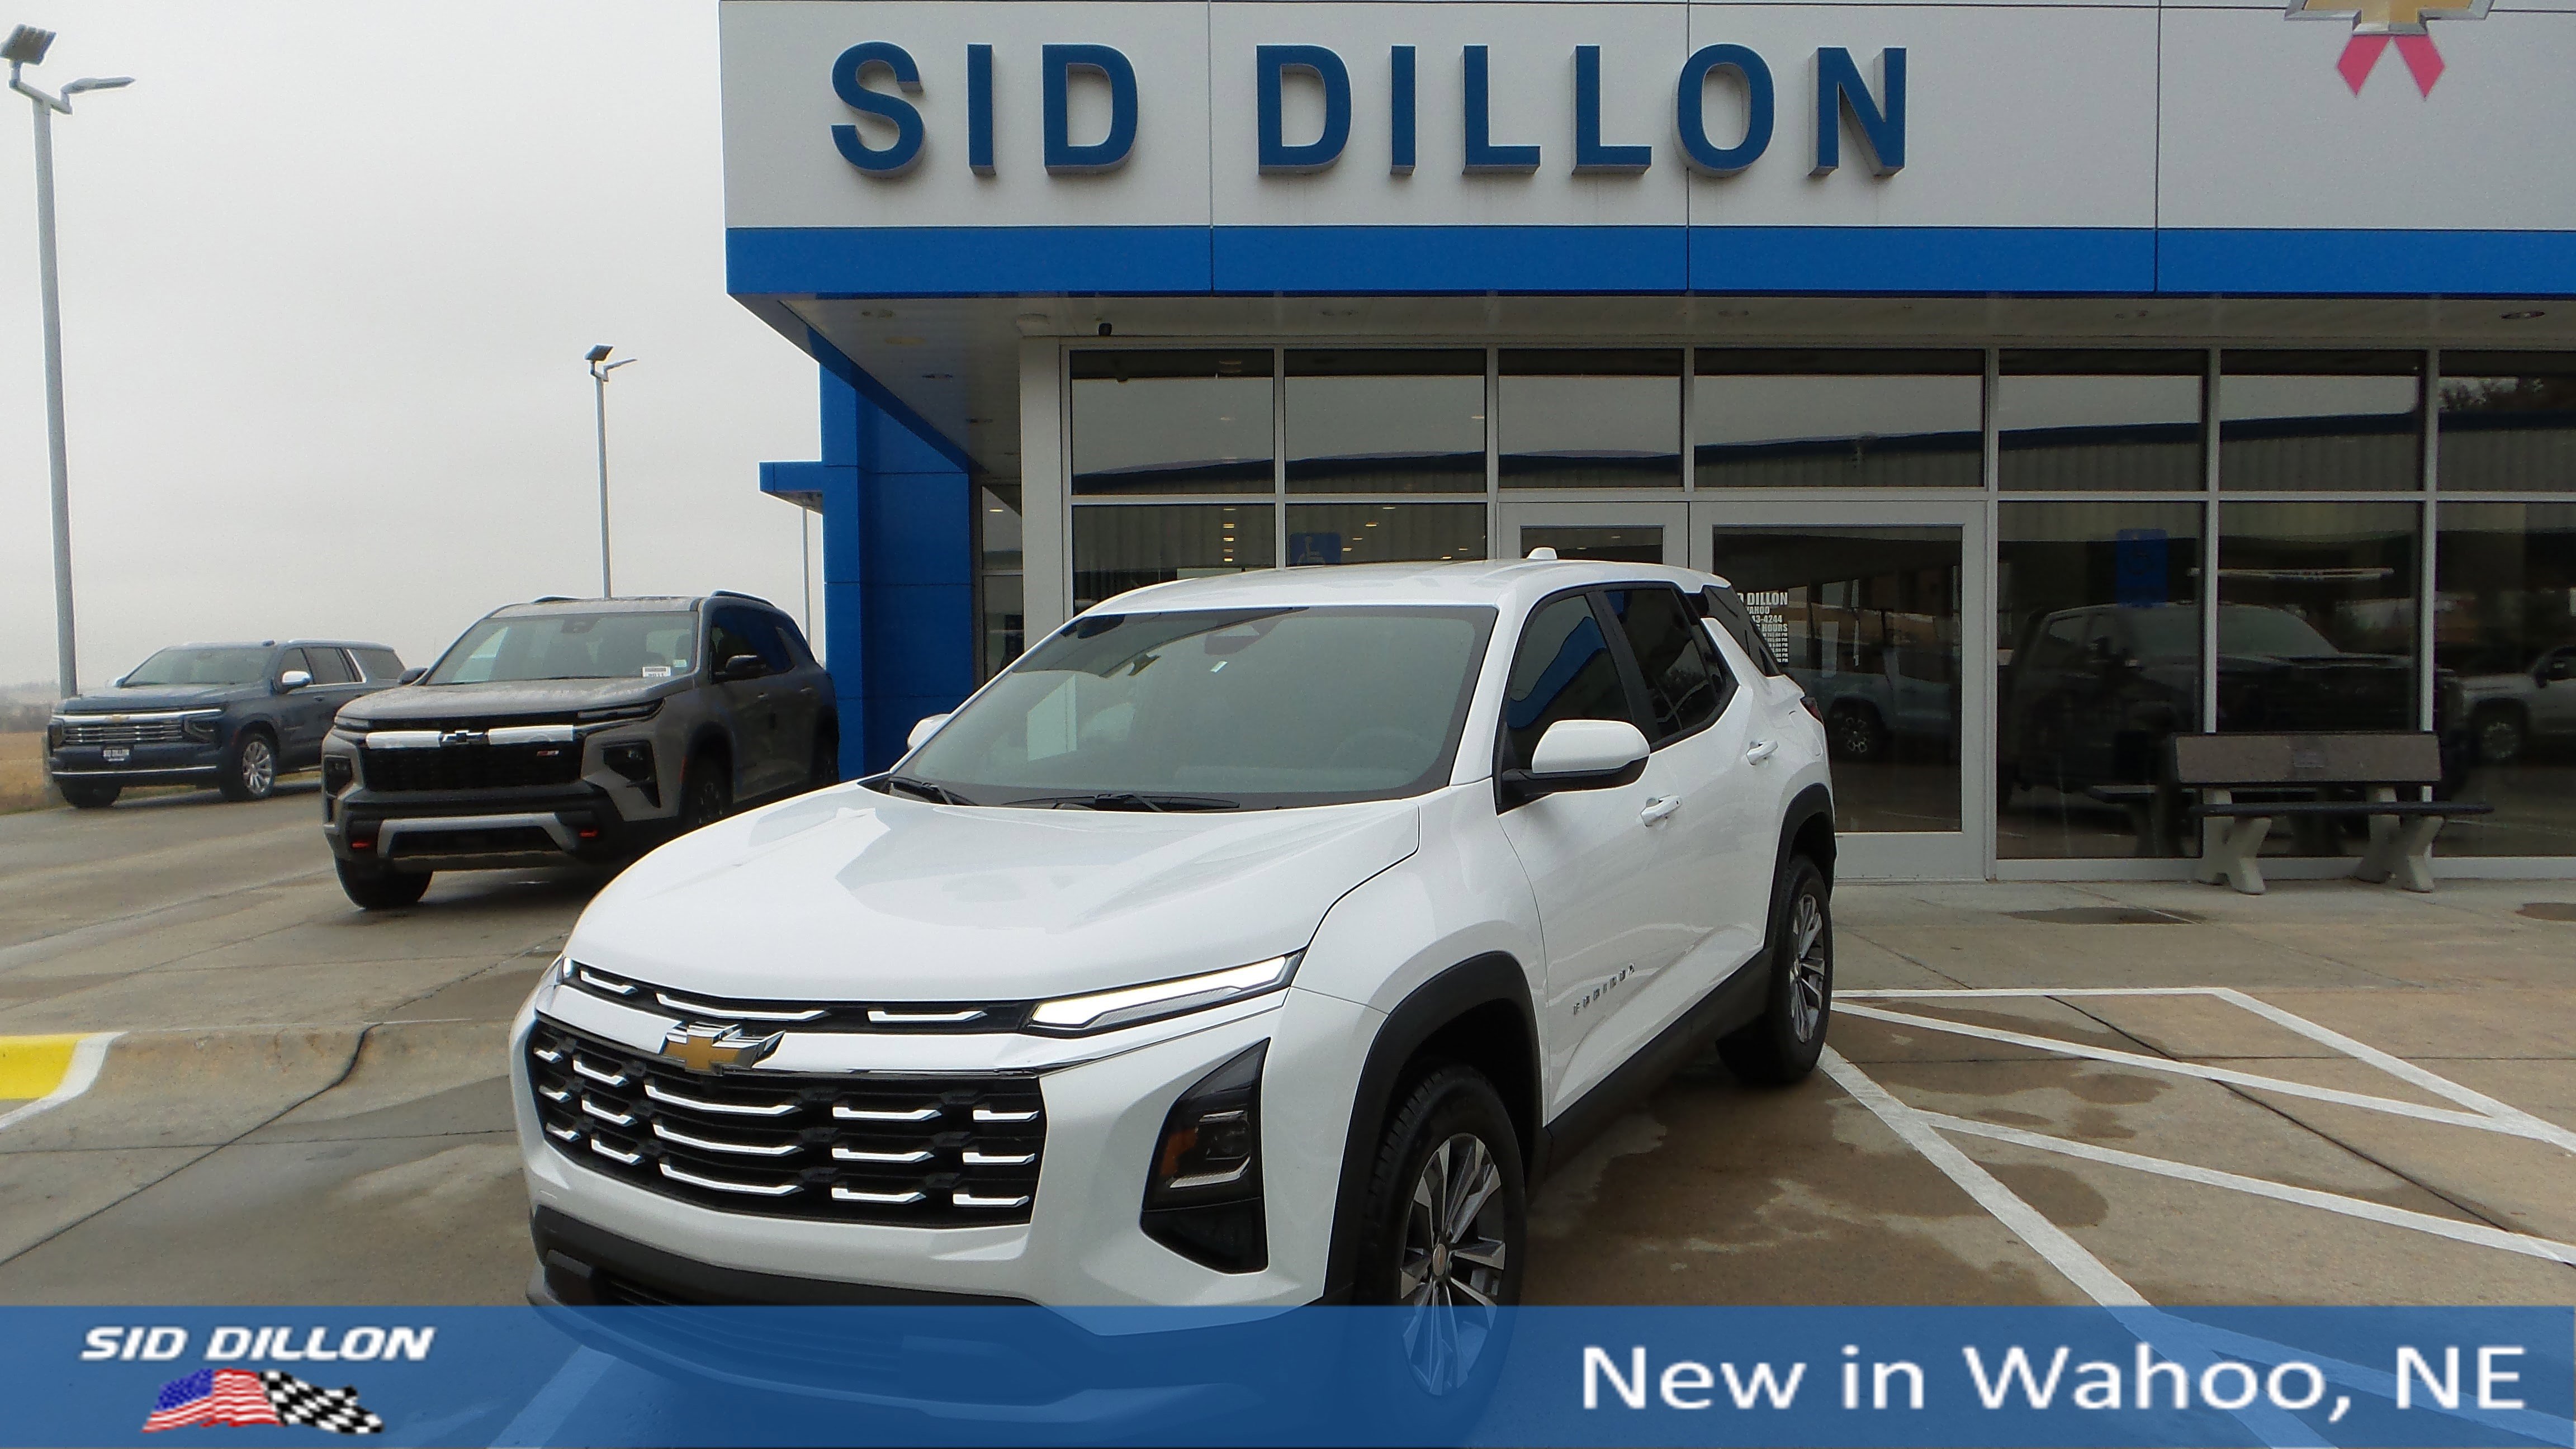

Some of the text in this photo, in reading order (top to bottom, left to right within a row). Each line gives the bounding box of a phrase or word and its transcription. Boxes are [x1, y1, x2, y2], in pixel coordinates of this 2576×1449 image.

[831, 41, 1906, 177] SID DILLON
[1747, 593, 1788, 605] DILLON
[1762, 624, 1788, 632] HOURS
